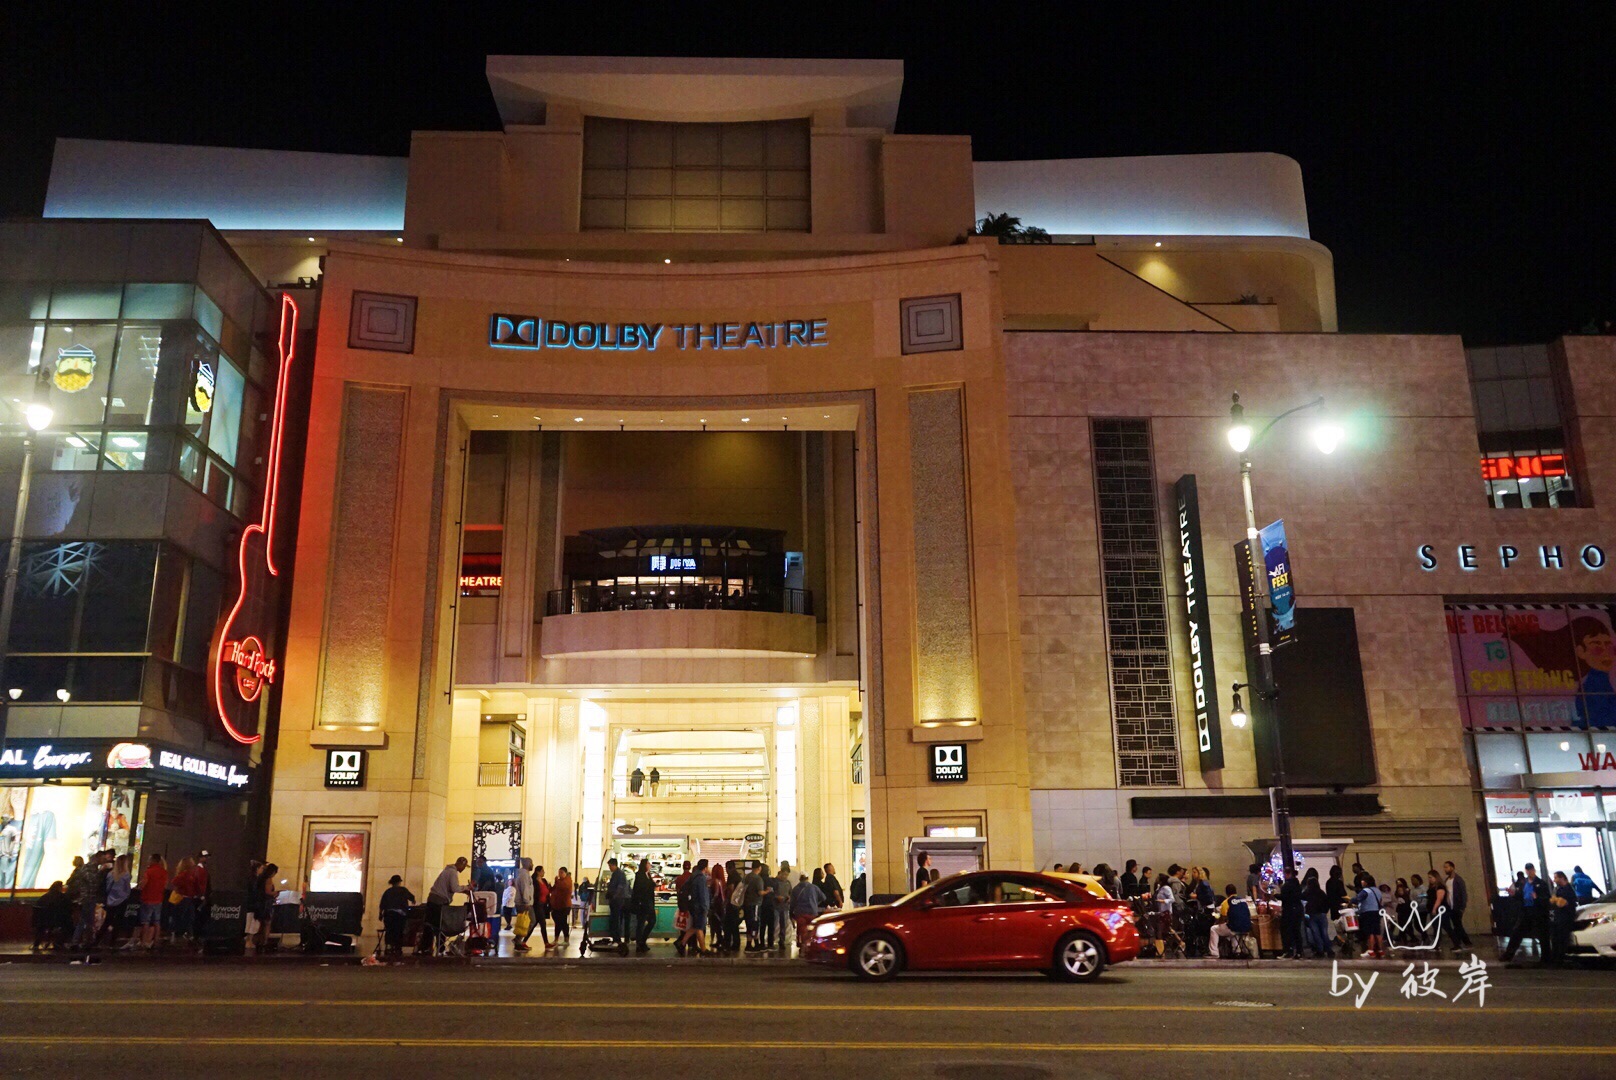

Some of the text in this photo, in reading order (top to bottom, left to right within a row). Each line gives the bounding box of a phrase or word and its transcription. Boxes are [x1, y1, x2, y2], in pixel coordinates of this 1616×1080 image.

[546, 318, 829, 351] DOLBY THEATRE
[1418, 544, 1605, 570] SEPHO
[1272, 563, 1285, 576] AFI
[460, 576, 502, 587] HEATRE
[1271, 573, 1289, 588] FEST
[1177, 494, 1206, 710] DOLBY THEATRE
[1472, 614, 1540, 634] BELONG
[231, 641, 276, 684] Hard Rock
[0, 749, 27, 765] AL
[160, 751, 182, 770] REAL
[207, 762, 227, 780] REAL
[1578, 752, 1616, 771] WA
[330, 772, 359, 780] DOLBY
[936, 766, 962, 774] DOLBY
[1494, 805, 1543, 816] Walgrees
